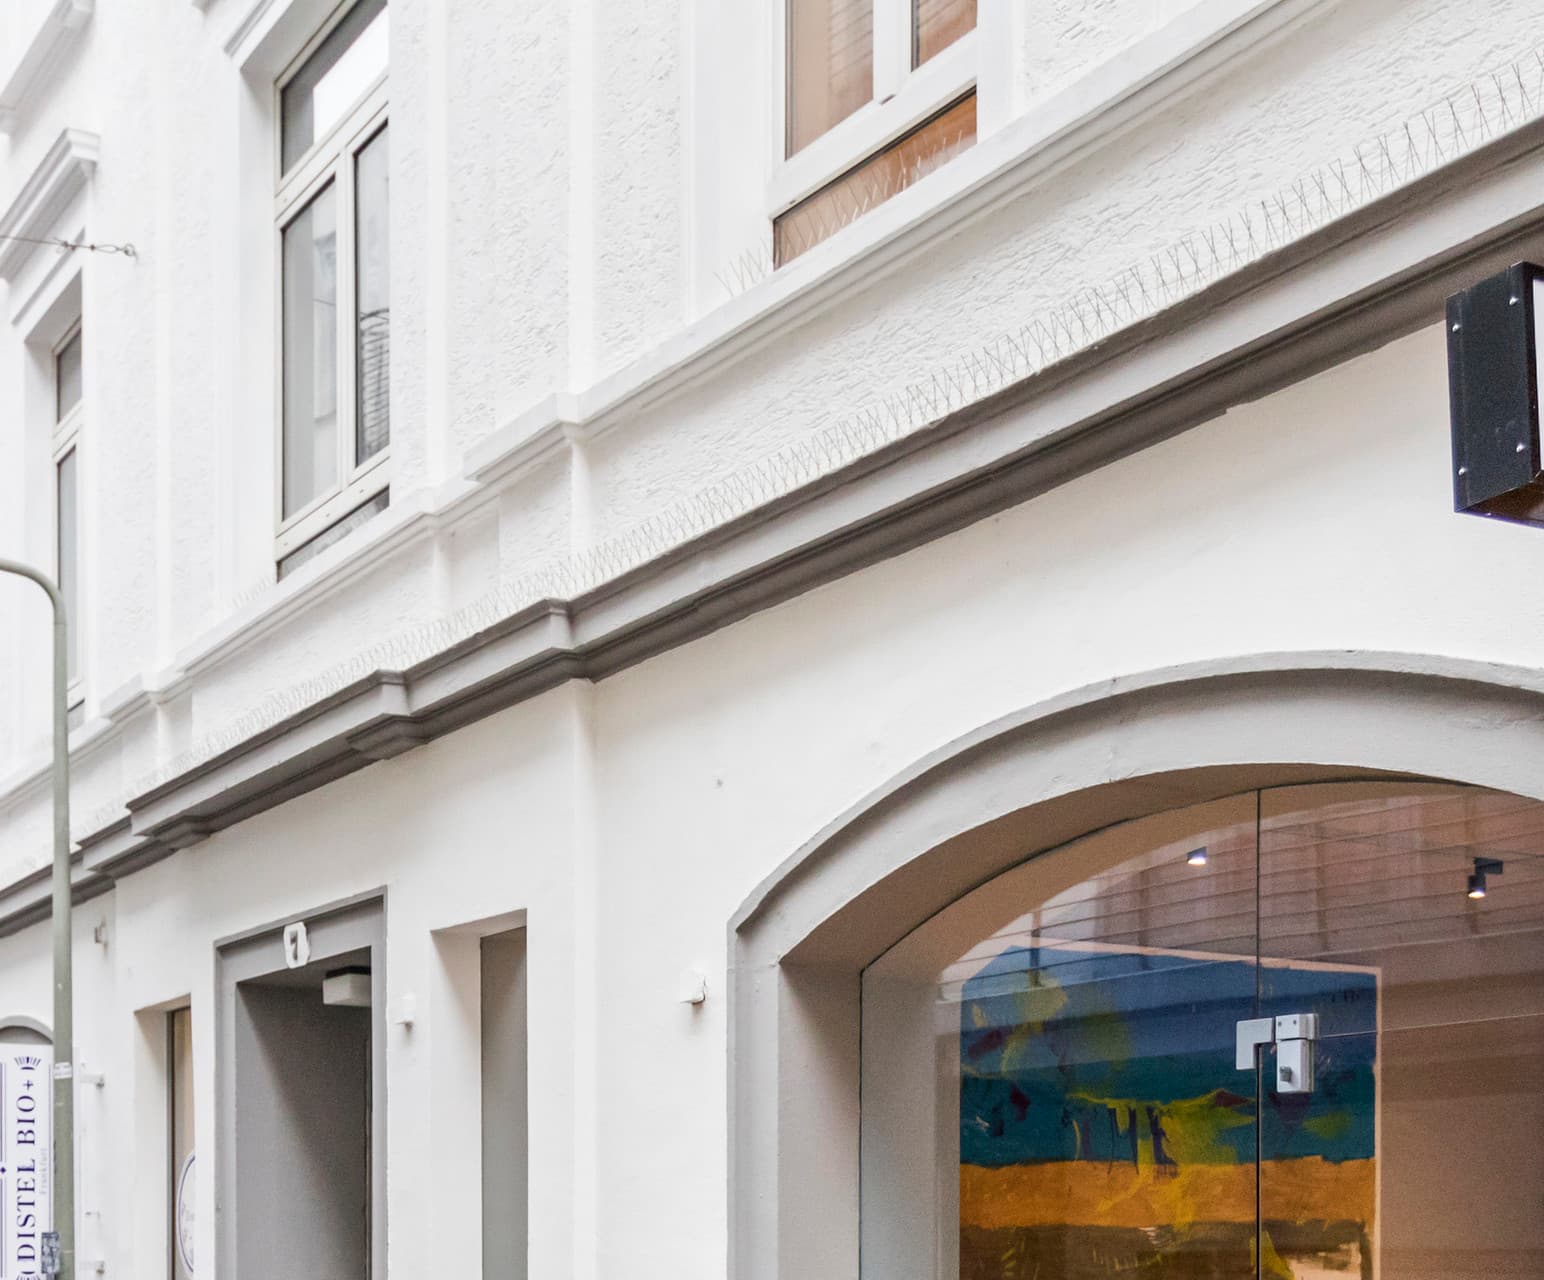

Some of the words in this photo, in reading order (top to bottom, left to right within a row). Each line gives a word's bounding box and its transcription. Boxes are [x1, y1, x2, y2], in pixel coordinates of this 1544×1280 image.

[17, 1079, 35, 1146] BIO+
[40, 1147, 48, 1195] Frankfurt
[17, 1158, 35, 1262] DISTEL
